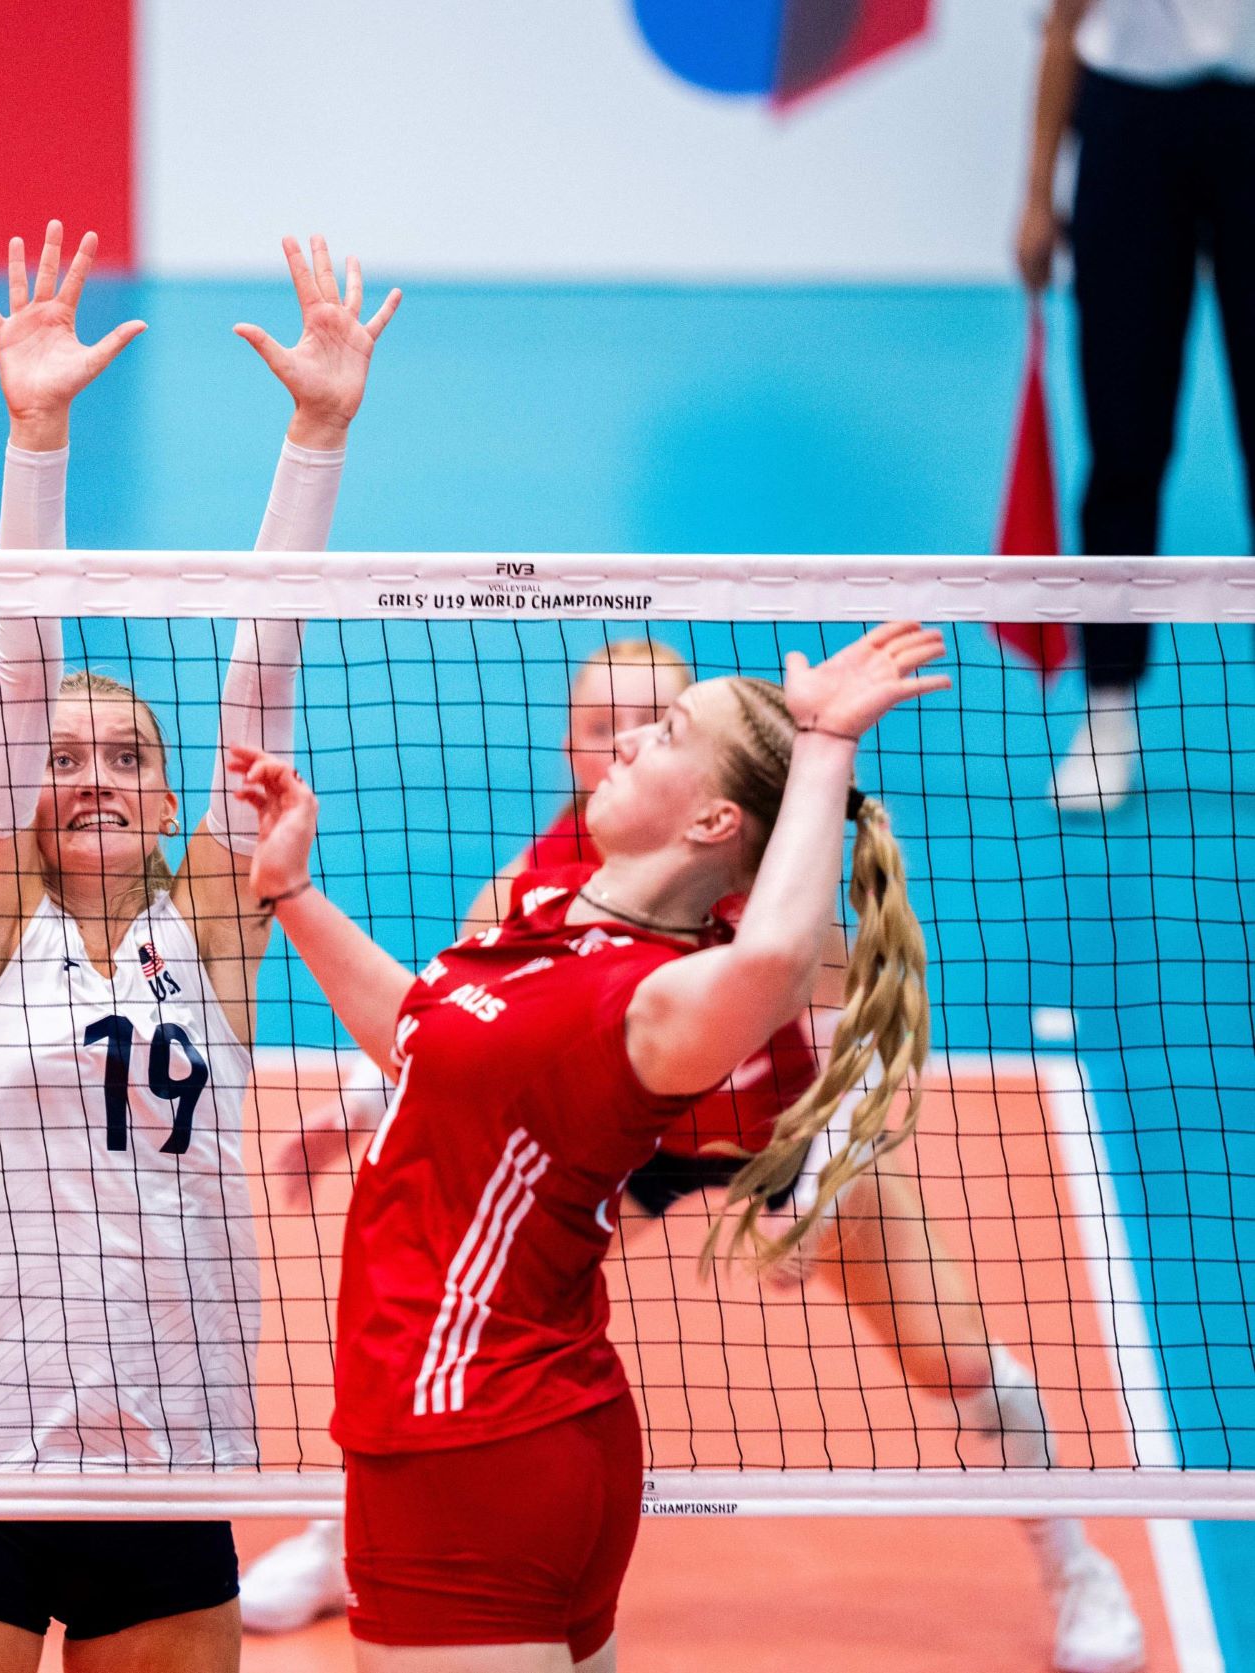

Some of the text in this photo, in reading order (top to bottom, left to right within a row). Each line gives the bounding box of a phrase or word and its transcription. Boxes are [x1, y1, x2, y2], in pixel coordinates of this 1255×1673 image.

[378, 593, 653, 610] GIRLS' U19 WORLD CHAMPIONSHIP
[83, 1015, 209, 1154] 19
[652, 1503, 738, 1514] CHAMPIONSHIP
